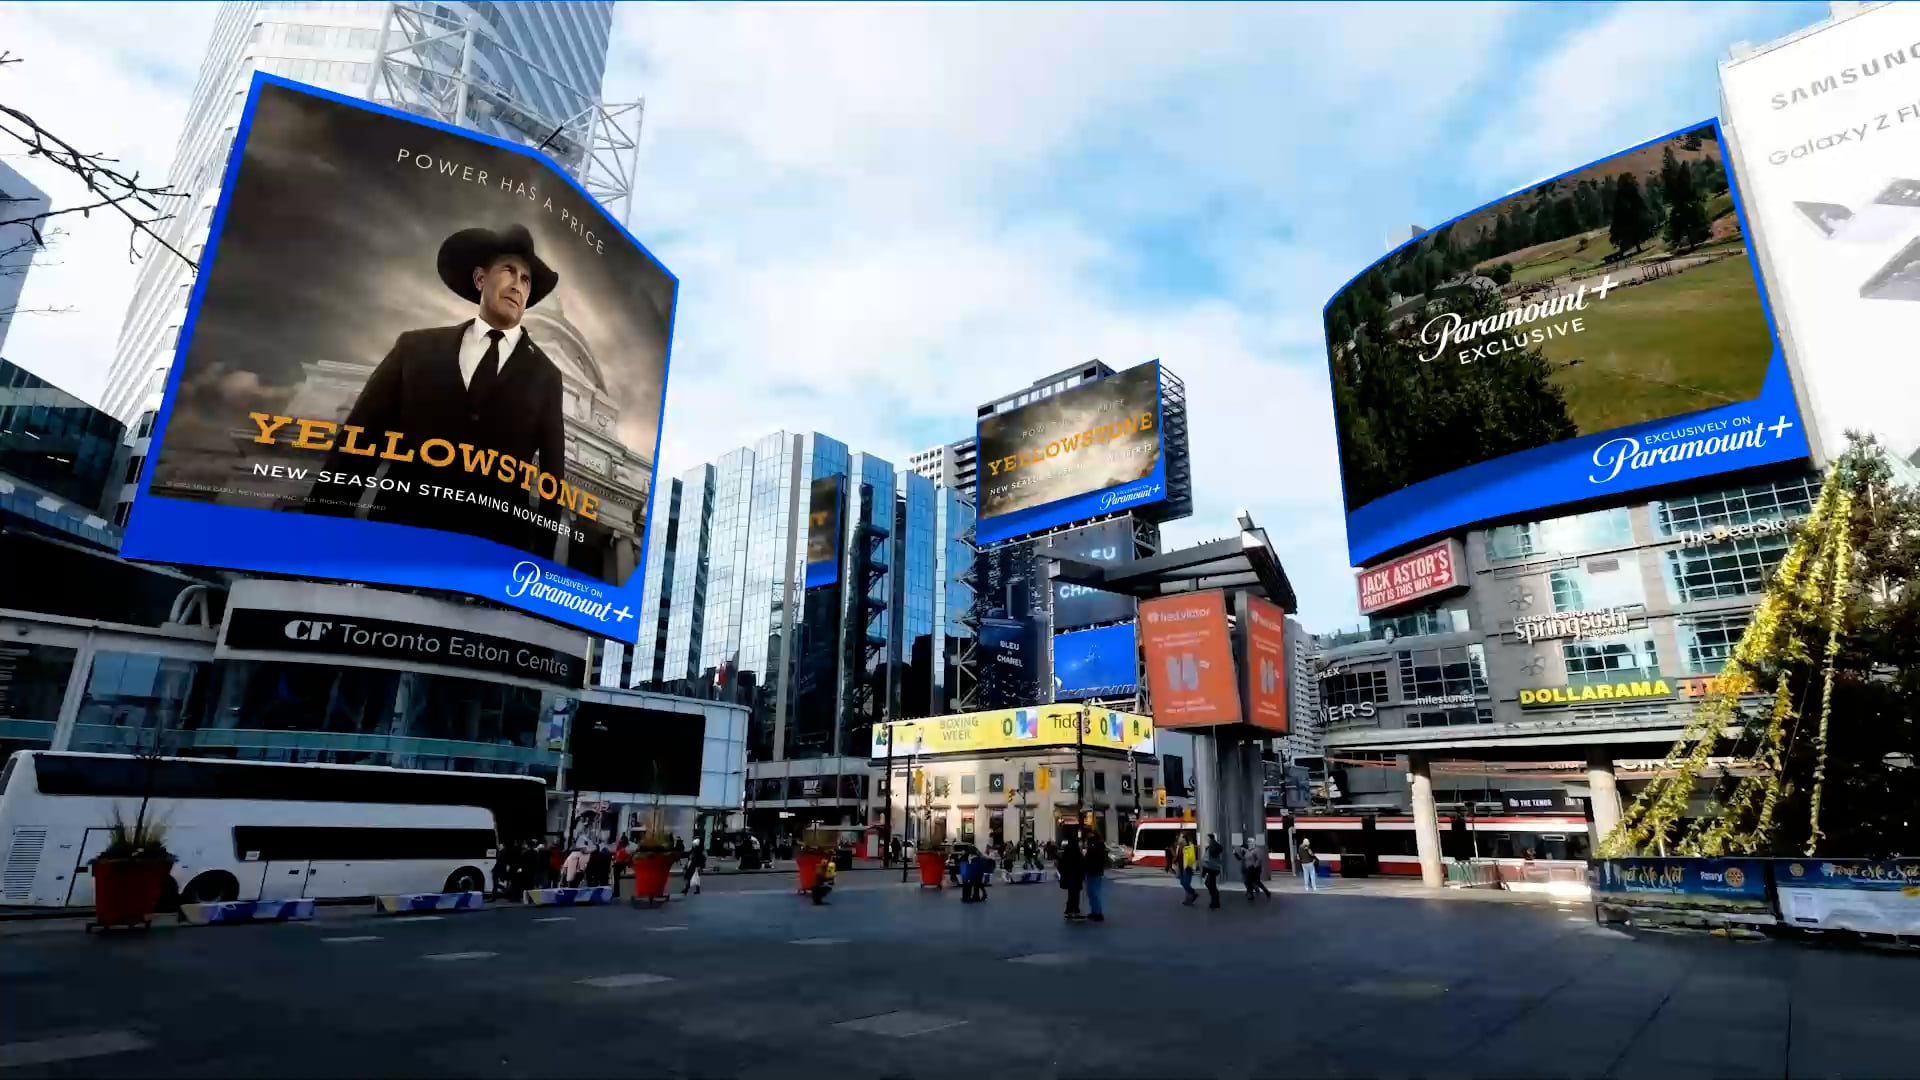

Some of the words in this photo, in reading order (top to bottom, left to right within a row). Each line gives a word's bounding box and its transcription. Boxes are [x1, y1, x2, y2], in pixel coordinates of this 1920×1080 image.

[1768, 123, 1867, 166] Galaxy
[1873, 113, 1891, 131] Z
[397, 148, 489, 186] POWER
[500, 176, 537, 201] HAS
[543, 197, 553, 213] A
[561, 208, 605, 255] PRICE
[1418, 274, 1619, 363] Paramount+
[1459, 317, 1586, 365] EXCLUSIVE
[987, 411, 1153, 476] YELLOWSTONE
[1588, 415, 1793, 484] Paramount+
[1645, 420, 1728, 445] EXCLUSIVELY
[1732, 415, 1752, 427] ON
[248, 411, 600, 521] YELLOWSTONE
[253, 463, 308, 480] NEW
[317, 471, 411, 493] SEASON
[418, 483, 509, 513] STREAMING
[513, 505, 571, 537] NOVEMBER
[573, 530, 585, 543] 13
[1680, 530, 1713, 545] The
[1714, 524, 1757, 541] Beer
[505, 561, 634, 622] Paramount+
[545, 571, 590, 593] EXCLUSIVELY
[591, 588, 603, 599] ON
[1362, 573, 1392, 597] JACK
[1394, 550, 1448, 584] ASTOR'S
[1363, 592, 1386, 609] PARTY
[1387, 588, 1394, 600] IS
[1395, 584, 1414, 597] THIS
[1414, 575, 1433, 592] WAY
[284, 620, 333, 641] CF
[340, 623, 441, 654] Toronto
[449, 636, 510, 664] Eaton
[516, 649, 569, 678] Centre
[1415, 694, 1475, 706] milestones
[1519, 679, 1671, 705] DOLLARAMA
[940, 716, 980, 729] BOXING
